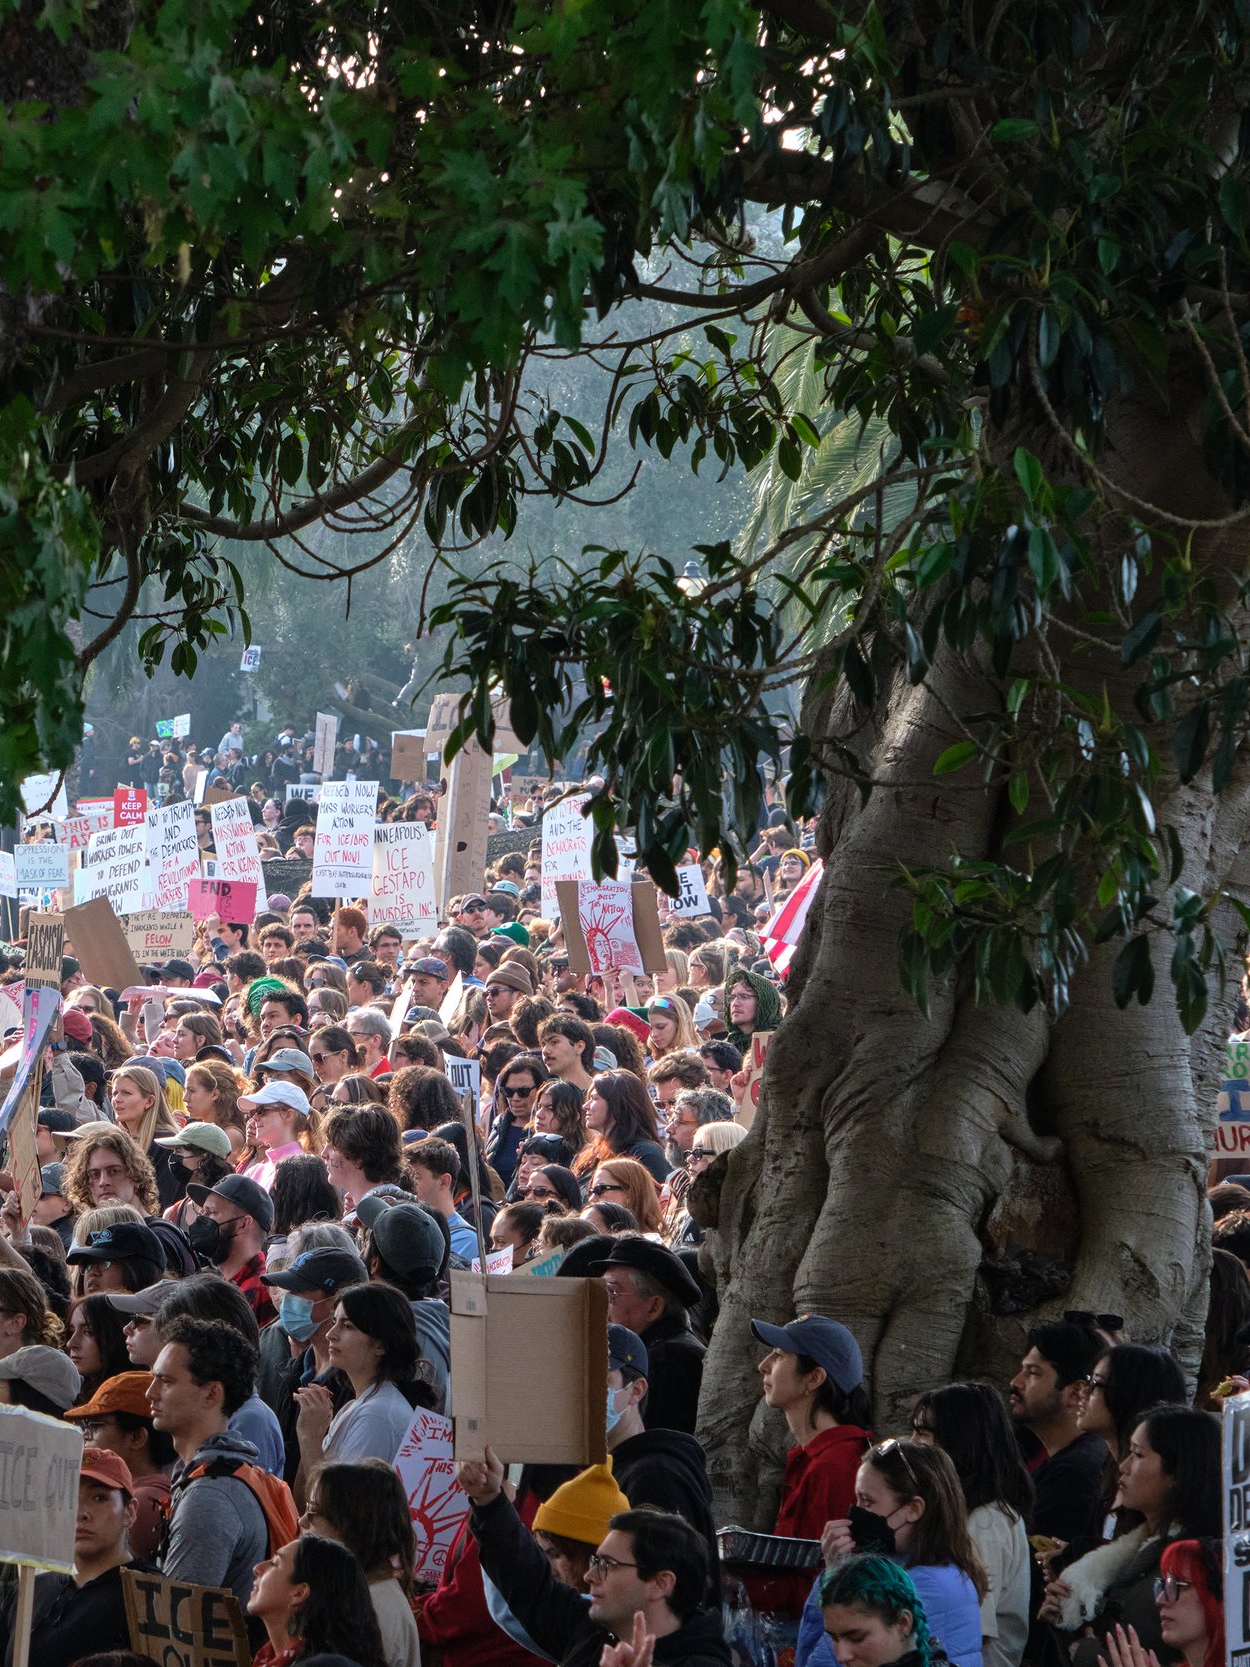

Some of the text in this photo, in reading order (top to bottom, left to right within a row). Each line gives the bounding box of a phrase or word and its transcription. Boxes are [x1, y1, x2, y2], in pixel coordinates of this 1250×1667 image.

[291, 788, 314, 800] WE
[121, 802, 142, 810] KEEP
[320, 802, 374, 816] MASS WORKERS
[120, 812, 142, 820] CALM
[148, 814, 158, 828] NO
[170, 802, 193, 824] TRUMP
[62, 816, 108, 834] THIS IS
[332, 816, 354, 830] ACTION
[550, 818, 582, 837] AND THE
[96, 831, 117, 847] BRING
[121, 826, 139, 840] OUT
[164, 826, 180, 842] AND
[317, 833, 331, 846] FOR
[374, 826, 424, 844] INNEAPOLIS:
[16, 845, 64, 856] OPPRESSION
[89, 842, 143, 864] WORKERS POWER
[162, 836, 196, 858] DEMOCRATS
[226, 840, 246, 858] ACTION
[546, 836, 586, 858] DEMOCRATS
[324, 850, 360, 864] OUT NOW!
[386, 848, 410, 872] ICE
[574, 854, 578, 867] A
[17, 868, 67, 880] MASK OF FEAR
[109, 859, 140, 880] DEFEND
[222, 861, 238, 876] FOR
[92, 878, 138, 900] IMMIGRANTS
[201, 881, 232, 896] END
[373, 871, 425, 897] GESTAPO
[586, 884, 628, 894] IMMIGRATION
[110, 898, 123, 913] OW
[396, 893, 405, 906] IS
[588, 900, 626, 914] THIS NATION
[130, 912, 192, 921] THEY'RE DEPORTING
[372, 901, 436, 922] MURDER INC.
[130, 923, 158, 932] INNOCENTS
[26, 920, 64, 972] FASCISM
[146, 933, 173, 944] FELON
[142, 949, 150, 958] IN
[150, 950, 158, 958] THE
[160, 948, 176, 958] WHITE
[451, 1064, 472, 1088] OUT
[424, 1457, 453, 1475] THIS
[46, 1453, 80, 1511] OUT
[135, 1580, 234, 1652] ICE
